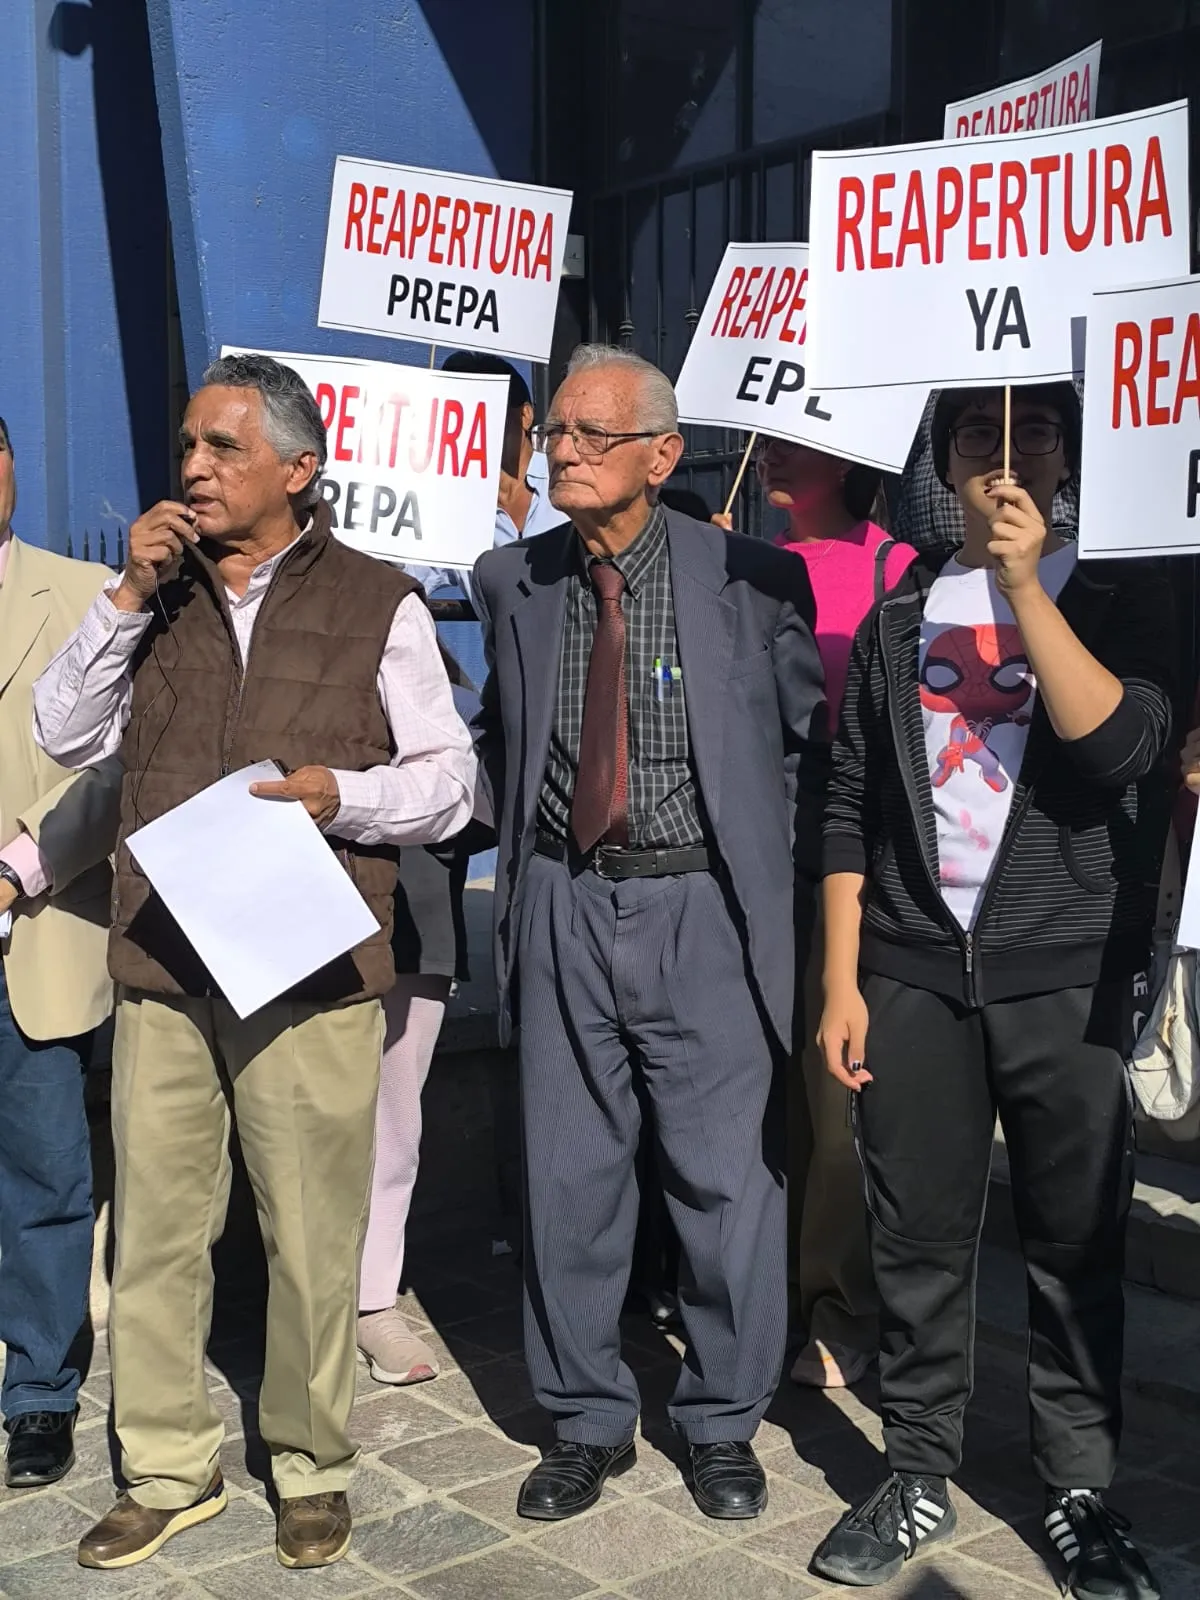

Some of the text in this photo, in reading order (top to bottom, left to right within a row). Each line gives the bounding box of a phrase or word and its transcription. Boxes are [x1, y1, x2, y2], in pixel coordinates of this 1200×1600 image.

[344, 183, 553, 282] REAPERTURA
[836, 136, 1172, 272] REAPERTURA
[386, 274, 499, 333] PREPA
[711, 266, 808, 345] REAPE
[965, 286, 1031, 351] YA
